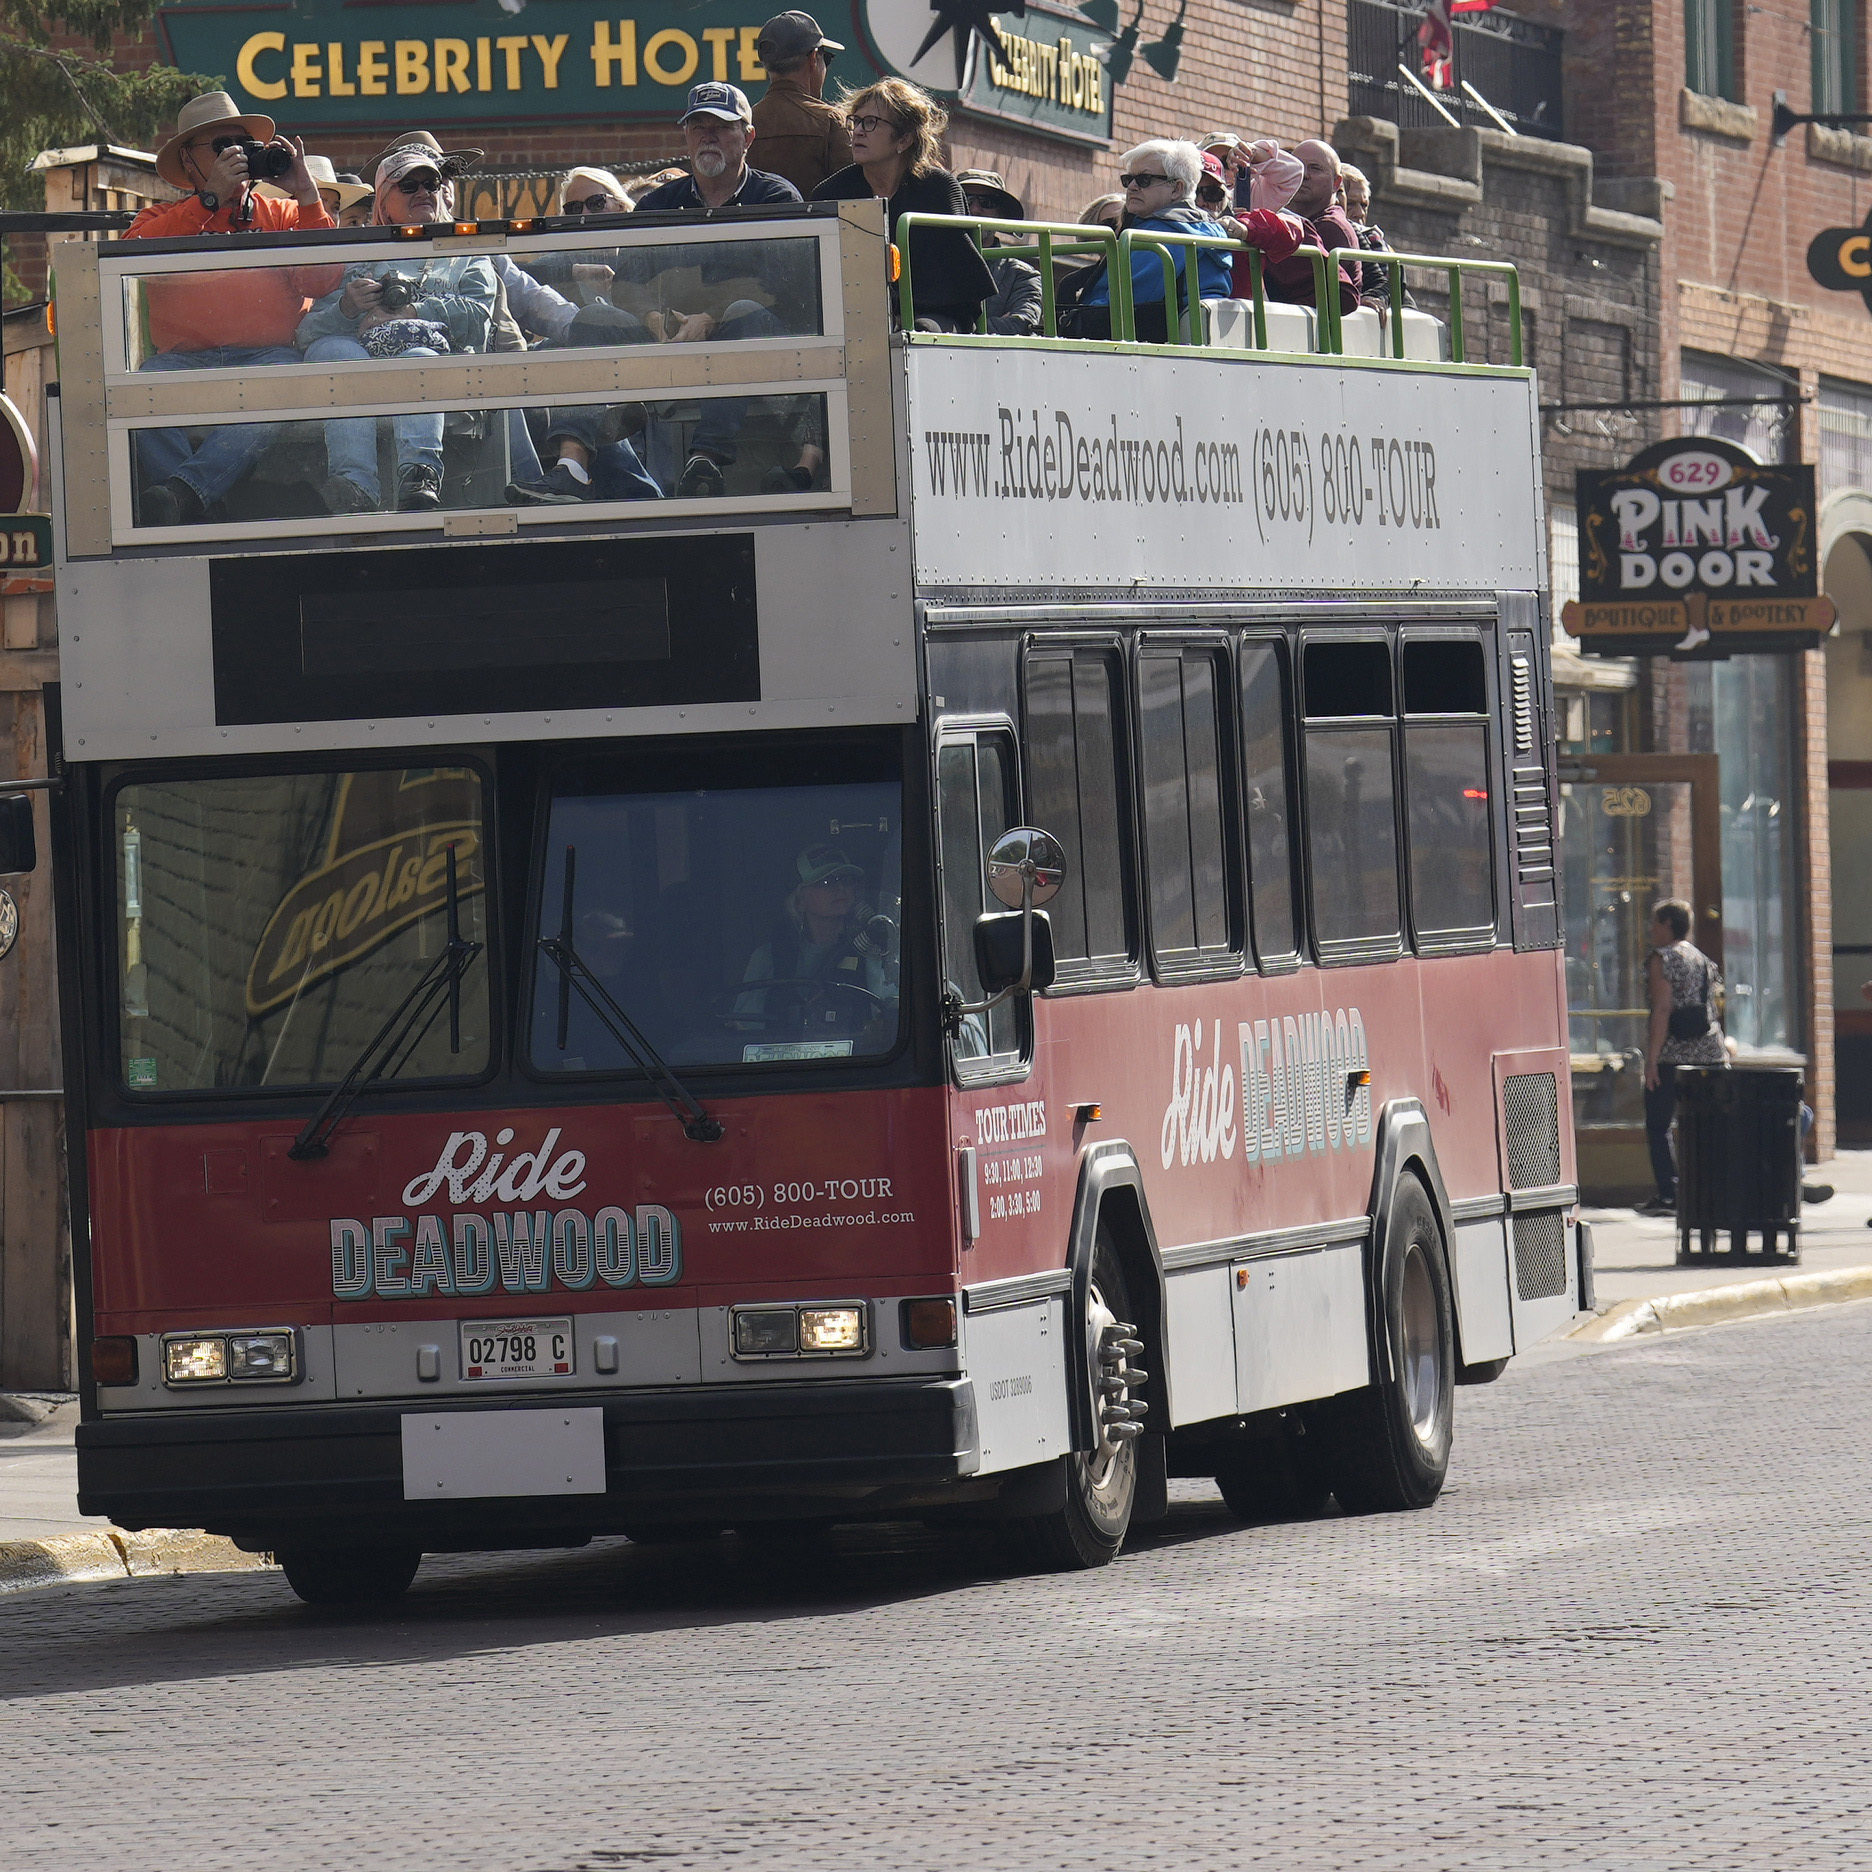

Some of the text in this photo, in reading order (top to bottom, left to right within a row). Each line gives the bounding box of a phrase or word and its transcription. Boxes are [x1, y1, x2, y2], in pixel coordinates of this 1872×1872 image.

[236, 19, 766, 101] CELEBRITY HOTE
[1059, 37, 1105, 114] HOTEL
[925, 407, 1441, 548] www.RideDeadwood.com (605) 800-TOUR
[1669, 462, 1720, 486] 629
[1610, 485, 1780, 553] PINK
[1619, 550, 1778, 589] DOOR
[1584, 602, 1811, 628] BOUTIQUE & BOOTERY
[1161, 1008, 1371, 1170] Ride DEADWOOD
[975, 1100, 1047, 1145] TOUR TIMES
[402, 1128, 587, 1207] Ride
[984, 1155, 1043, 1188] 9:30, 11:00, 12:30
[704, 1178, 894, 1212] (605) 800-TOUR
[989, 1189, 1042, 1222] 2:00, 3:30, 5:00
[708, 1210, 916, 1233] www.RideDeadwood.com
[330, 1204, 680, 1297] DEADWOOD
[469, 1334, 565, 1364] 02798 C
[989, 1379, 1009, 1402] USDOT
